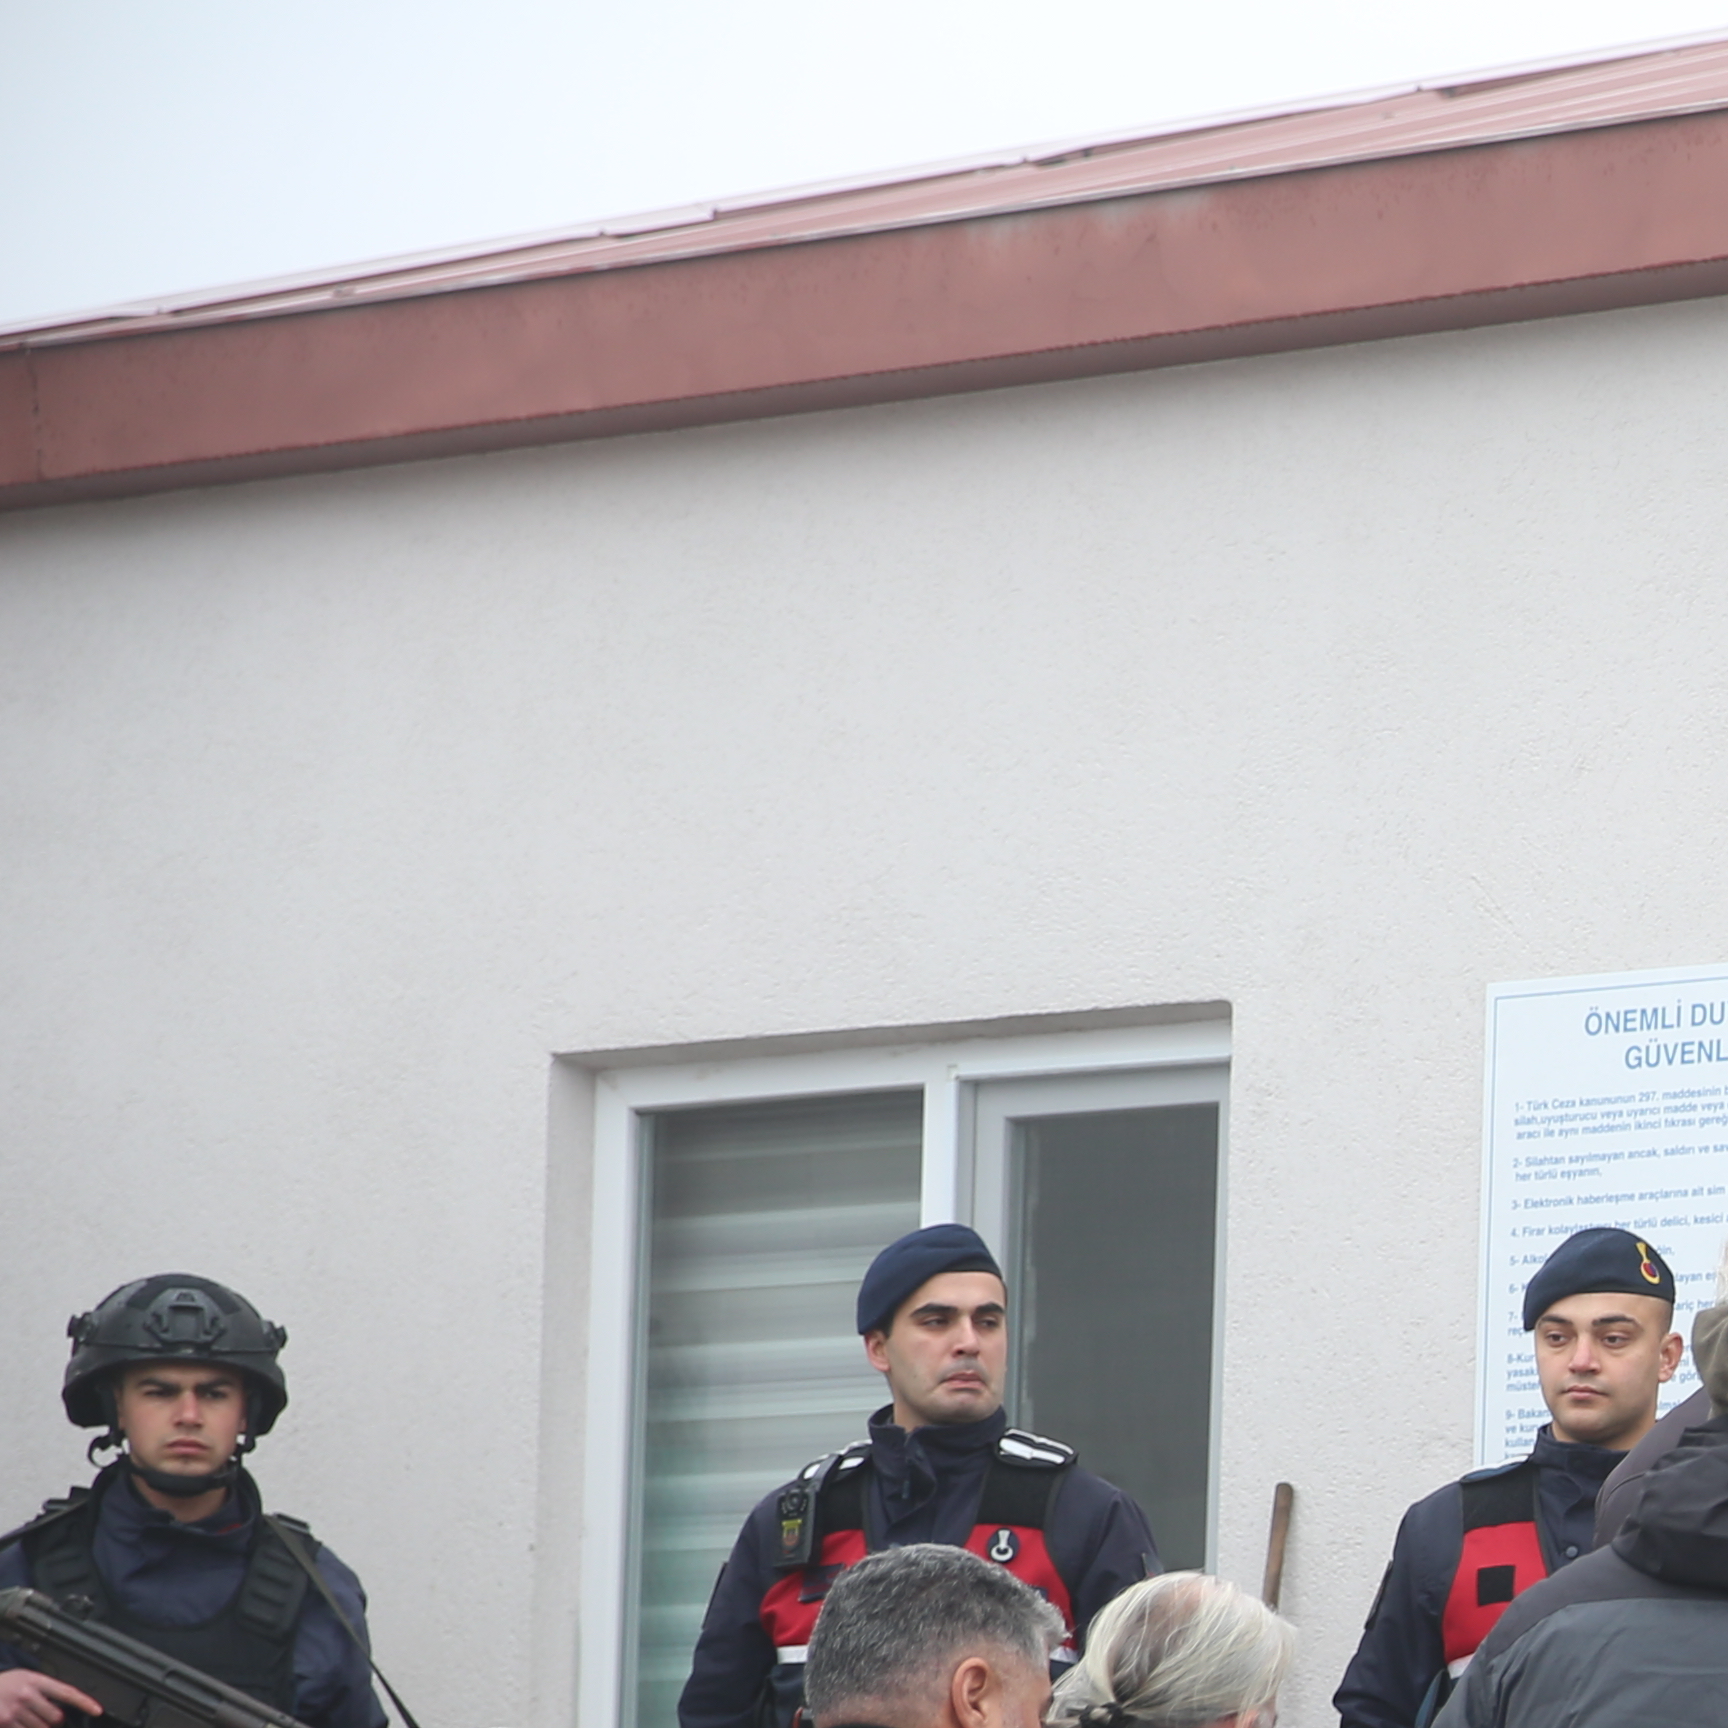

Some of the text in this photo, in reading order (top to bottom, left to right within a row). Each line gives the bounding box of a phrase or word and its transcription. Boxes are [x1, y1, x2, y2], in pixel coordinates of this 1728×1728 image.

[1584, 999, 1682, 1036] ÖNEMLİ
[1527, 1100, 1549, 1111] Türk
[1552, 1098, 1576, 1109] Ceza
[1638, 1091, 1659, 1102] 297.
[1600, 1109, 1624, 1121] veya
[1663, 1102, 1698, 1114] madde
[1701, 1102, 1724, 1113] veya
[1698, 1143, 1709, 1153] ve
[1515, 1171, 1532, 1182] her
[1524, 1196, 1573, 1209] Elektronik
[1707, 1184, 1725, 1196] sim
